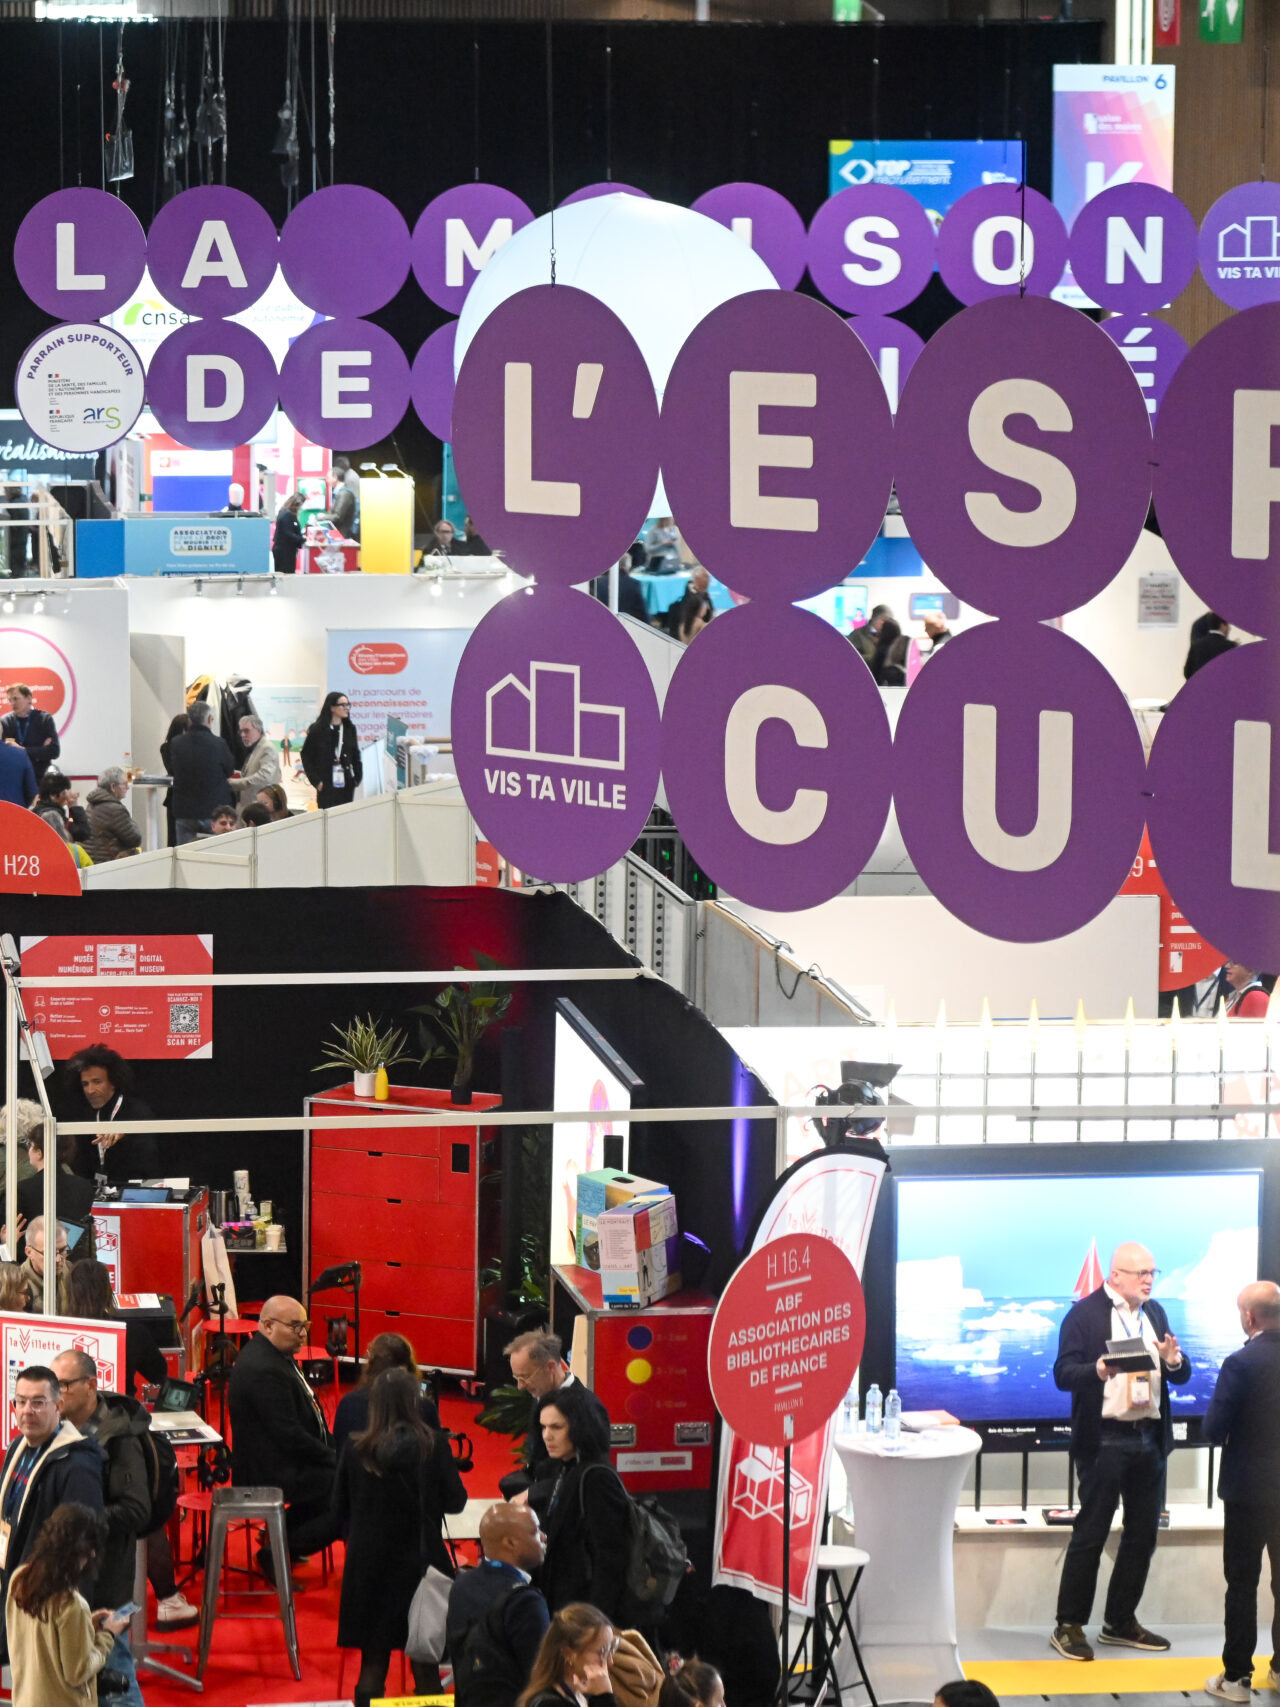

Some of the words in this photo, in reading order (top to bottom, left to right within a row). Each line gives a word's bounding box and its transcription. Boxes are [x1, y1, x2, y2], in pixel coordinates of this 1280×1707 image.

[1154, 74, 1167, 90] 6
[56, 219, 249, 291] LA
[1217, 266, 1242, 279] VIS
[1244, 266, 1262, 279] TA
[1264, 266, 1280, 279] VI
[142, 311, 190, 326] cnsa
[26, 337, 66, 380] PARRAIN
[67, 333, 134, 377] SUPPORTEUR
[186, 350, 373, 423] DE
[83, 406, 121, 430] ars
[348, 688, 361, 696] Un
[363, 689, 406, 697] parcours
[408, 688, 421, 696] de
[483, 768, 521, 798] VIS
[526, 773, 556, 802] TA
[560, 778, 627, 811] VILLE
[4, 854, 40, 877] H28
[84, 944, 94, 952] UN
[140, 944, 144, 952] A
[1170, 942, 1196, 950] PAVILLON
[1196, 942, 1202, 950] 6
[58, 964, 94, 974] NUMÉRIQUE
[140, 965, 165, 973] MUSEUM
[74, 954, 94, 963] MUSÉE
[140, 954, 163, 962] DIGITAL
[167, 1038, 185, 1046] SCAN
[766, 1254, 778, 1280] H
[782, 1245, 812, 1275] 16.4
[775, 1292, 803, 1314] ABF
[728, 1310, 820, 1348] ASSOCIATION
[824, 1302, 852, 1324] DES
[10, 1337, 18, 1347] la
[20, 1328, 61, 1354] Villette
[726, 1325, 850, 1372] BIBLIOTHECAIRES
[750, 1369, 768, 1388] DE
[772, 1353, 828, 1382] FRANCE
[774, 1399, 798, 1412] PAVILLON
